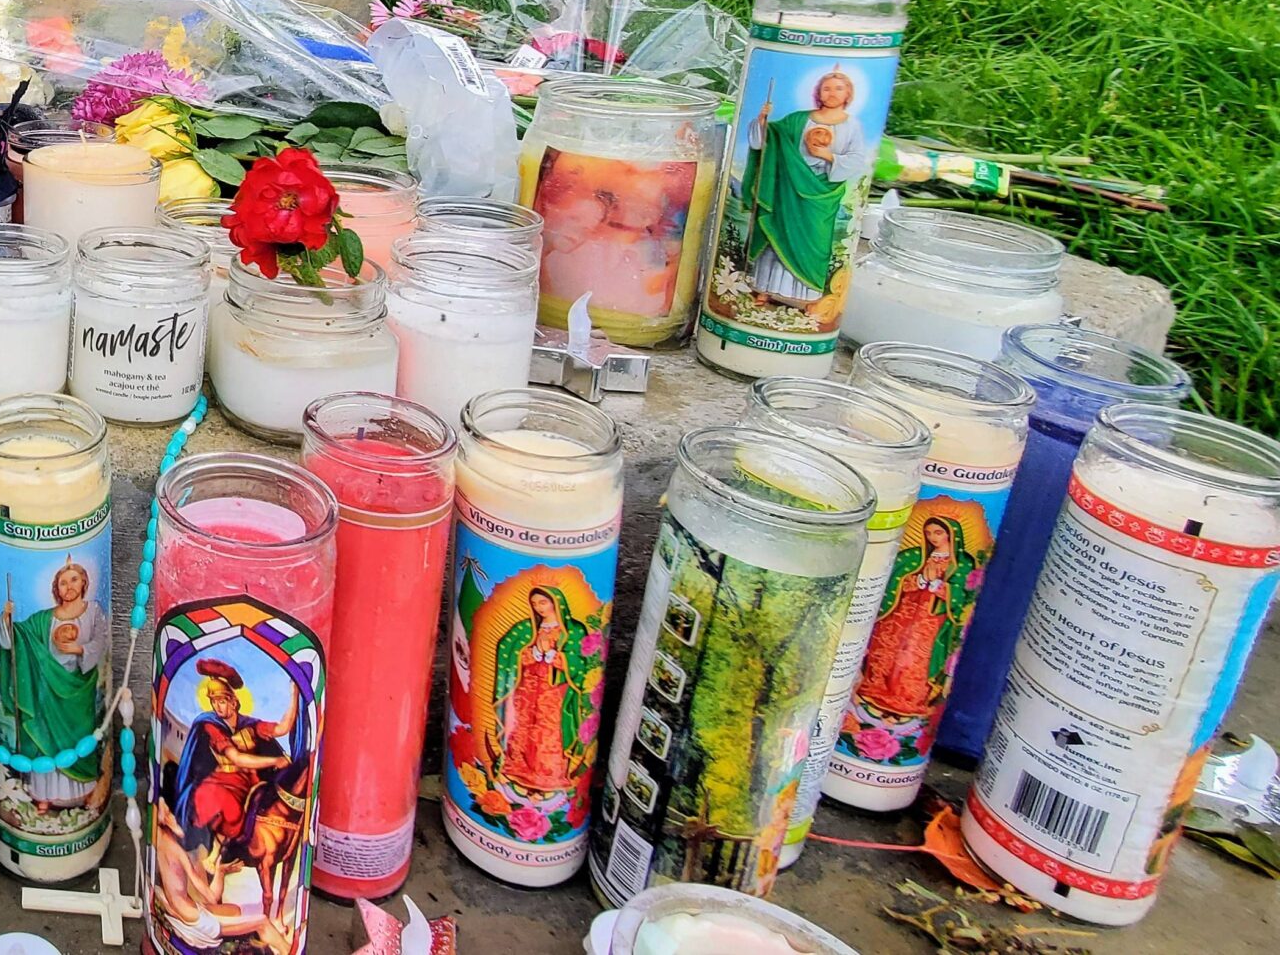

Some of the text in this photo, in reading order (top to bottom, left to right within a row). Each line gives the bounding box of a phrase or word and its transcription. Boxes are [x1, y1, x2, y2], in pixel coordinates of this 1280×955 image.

[779, 29, 805, 45] San
[807, 32, 853, 47] Judas
[82, 307, 197, 364] namaste
[747, 335, 812, 354] Saint Jude
[103, 368, 167, 382] mahogany & tea
[108, 380, 160, 392] acajou et thé
[924, 463, 948, 475] de
[4, 523, 33, 538] San
[34, 524, 77, 541] Judas
[469, 507, 515, 538] Virgen
[518, 531, 540, 544] de
[1092, 544, 1106, 556] al
[1099, 561, 1119, 575] de
[1119, 570, 1167, 594] Jesús
[1088, 577, 1111, 591] amor
[1111, 589, 1130, 601] que
[1074, 597, 1083, 606] tu
[1091, 607, 1131, 630] Sagrado
[1118, 612, 1137, 624] con
[1140, 619, 1151, 628] tu
[1122, 602, 1132, 611] la
[1135, 609, 1169, 624] gracia
[1172, 620, 1192, 630] que
[1057, 613, 1097, 641] Heart
[1119, 647, 1166, 670] Jesus
[1066, 635, 1083, 647] and
[1092, 649, 1116, 663] shall
[1117, 659, 1130, 669] be
[1072, 667, 1094, 680] your
[1075, 649, 1096, 664] light
[1098, 662, 1111, 671] up
[1114, 668, 1137, 680] your
[1080, 662, 1096, 674] ask
[1099, 671, 1123, 685] from
[1126, 683, 1145, 693] you
[1094, 688, 1117, 700] your
[855, 772, 875, 781] of
[1021, 745, 1059, 773] CONTENIDO
[1060, 770, 1082, 786] NETO:
[1090, 784, 1103, 794] OZ
[36, 844, 70, 856] Saint
[455, 817, 476, 838] Our
[479, 834, 512, 858] Lady
[515, 852, 534, 863] of
